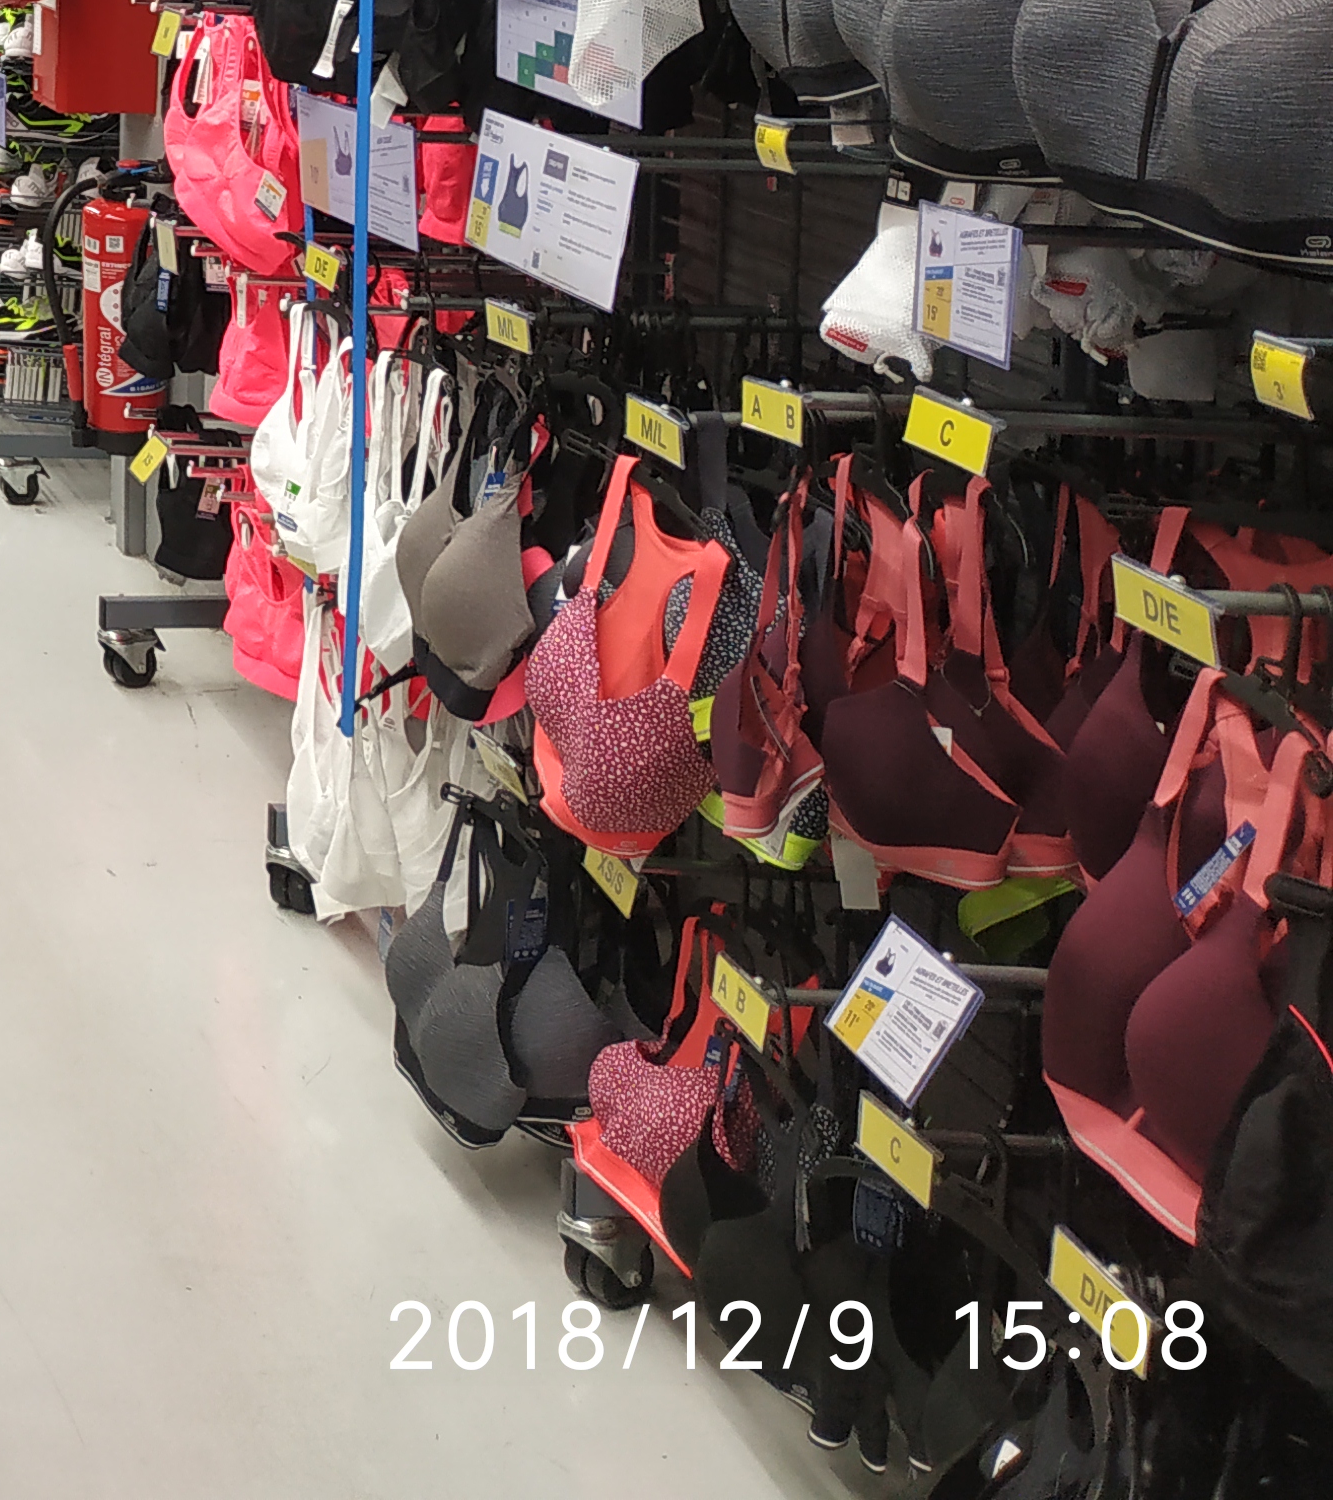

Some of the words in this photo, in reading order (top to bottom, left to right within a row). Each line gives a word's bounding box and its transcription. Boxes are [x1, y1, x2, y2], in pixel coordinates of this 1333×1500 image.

[496, 313, 519, 344] M/L
[751, 393, 763, 420] A
[784, 404, 796, 431] B
[639, 413, 668, 450] M/L
[938, 417, 955, 448] C
[1142, 588, 1182, 636] D/E
[596, 852, 630, 895] XS/S
[717, 974, 730, 997] A
[733, 985, 748, 1015] B
[888, 1134, 903, 1166] C
